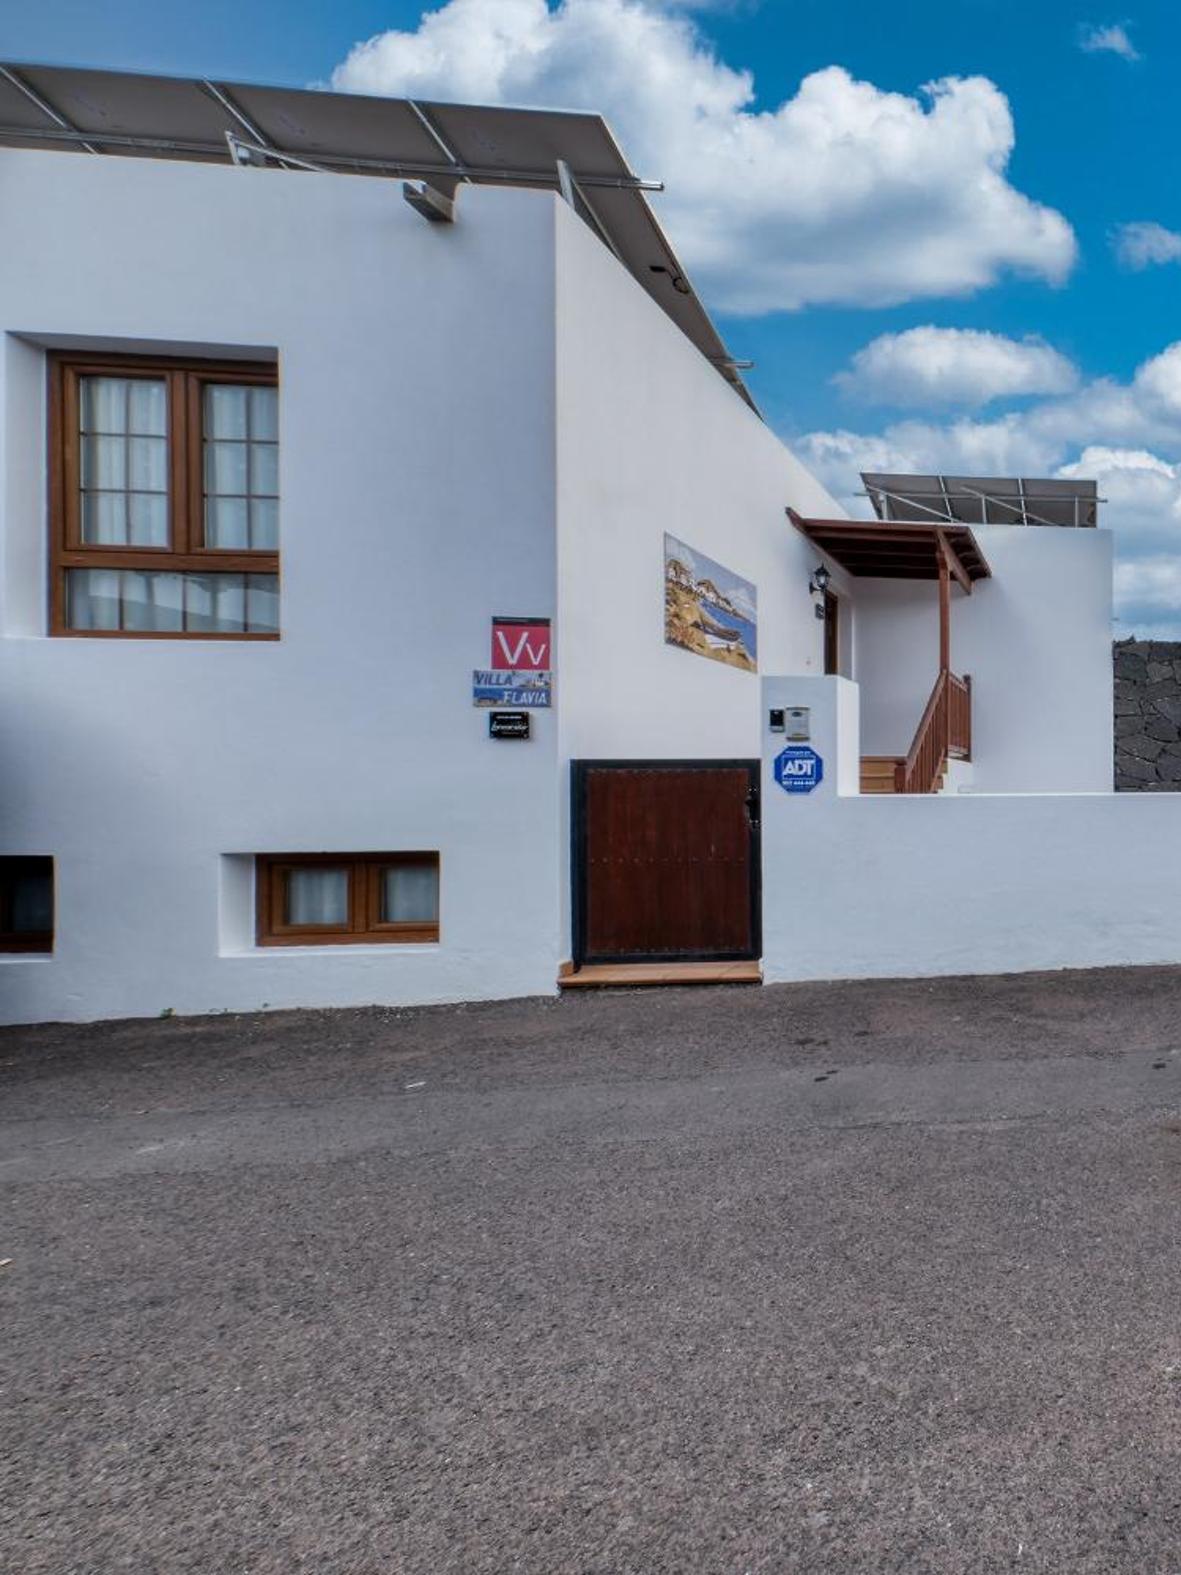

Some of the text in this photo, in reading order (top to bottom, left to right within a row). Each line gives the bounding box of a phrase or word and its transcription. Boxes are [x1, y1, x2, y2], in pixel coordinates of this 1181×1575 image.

[476, 673, 513, 686] VILLA
[503, 691, 547, 705] FLAVIA
[782, 759, 816, 776] ADT
